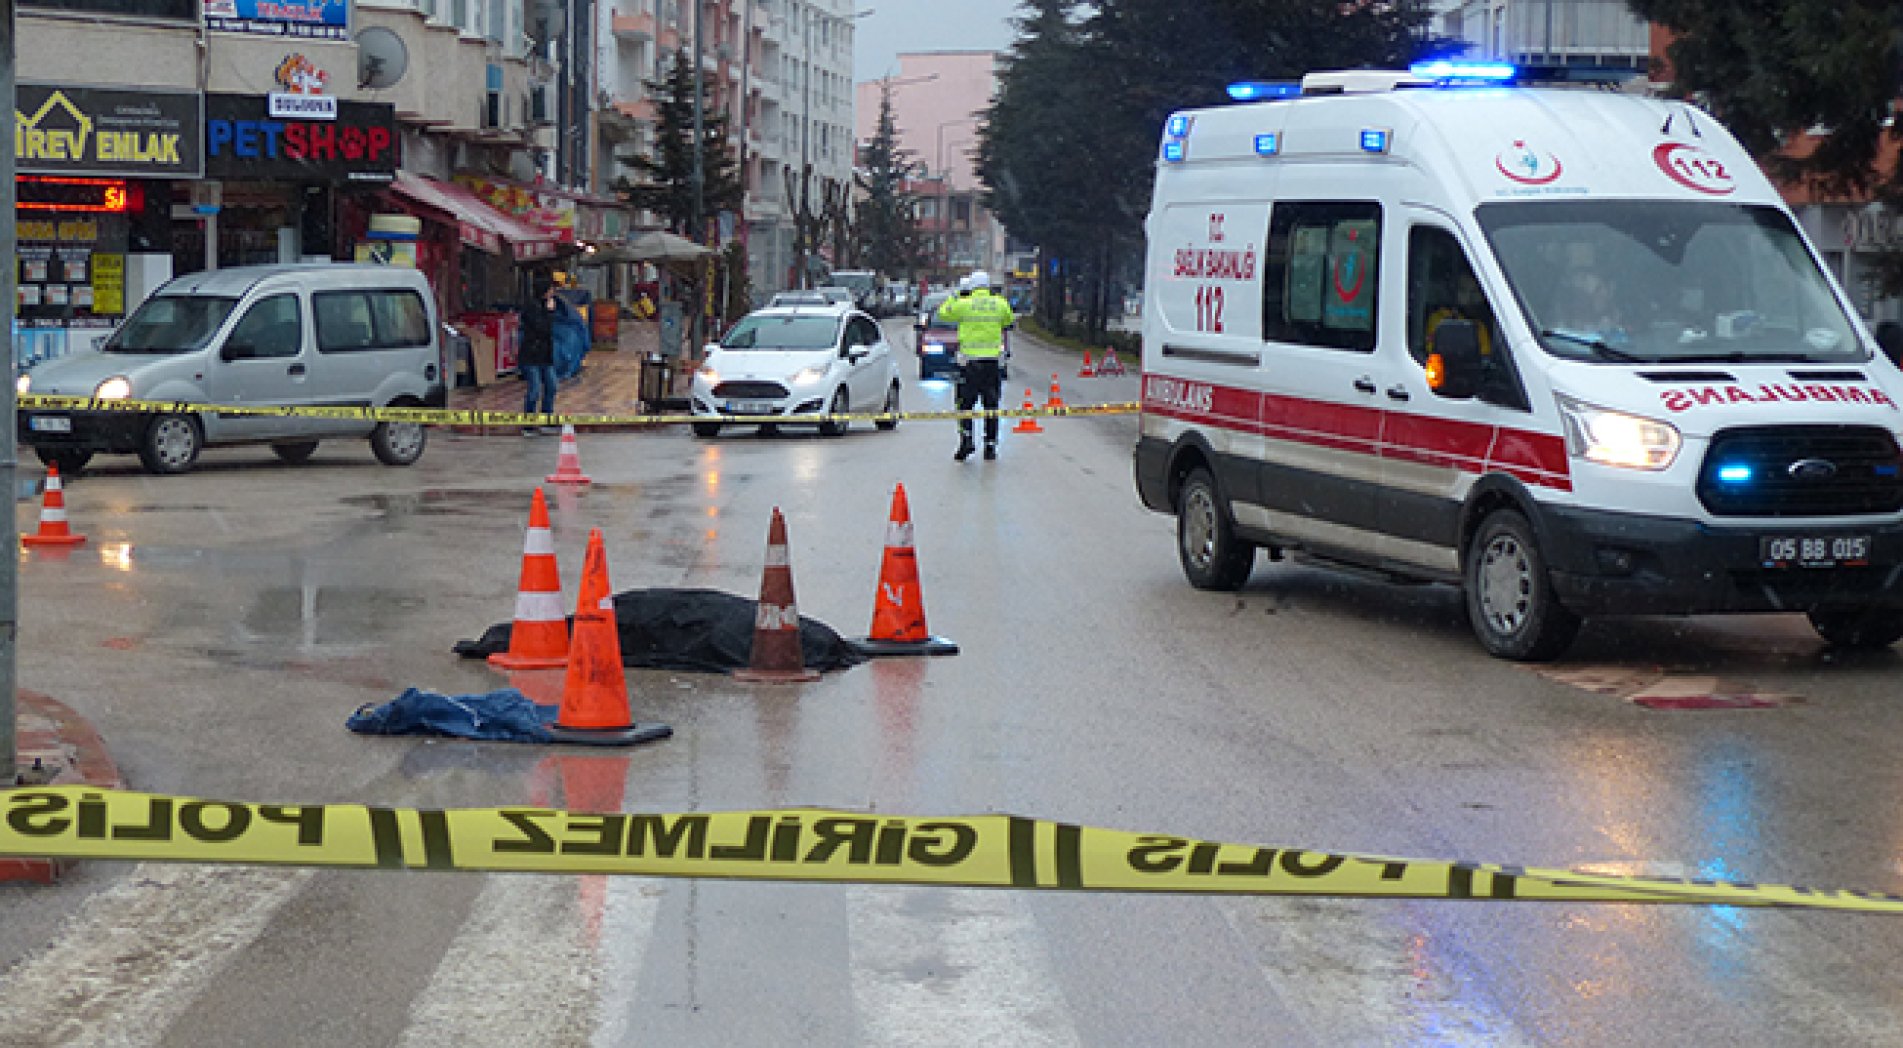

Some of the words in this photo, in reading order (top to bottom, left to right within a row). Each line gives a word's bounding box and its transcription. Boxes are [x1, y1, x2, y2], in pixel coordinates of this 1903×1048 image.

[96, 131, 181, 164] EMLAK
[1674, 157, 1732, 180] 112
[1195, 285, 1225, 335] 112
[1146, 374, 1213, 413] AMBULANS
[1770, 538, 1796, 560] 05
[1832, 537, 1867, 559] 015
